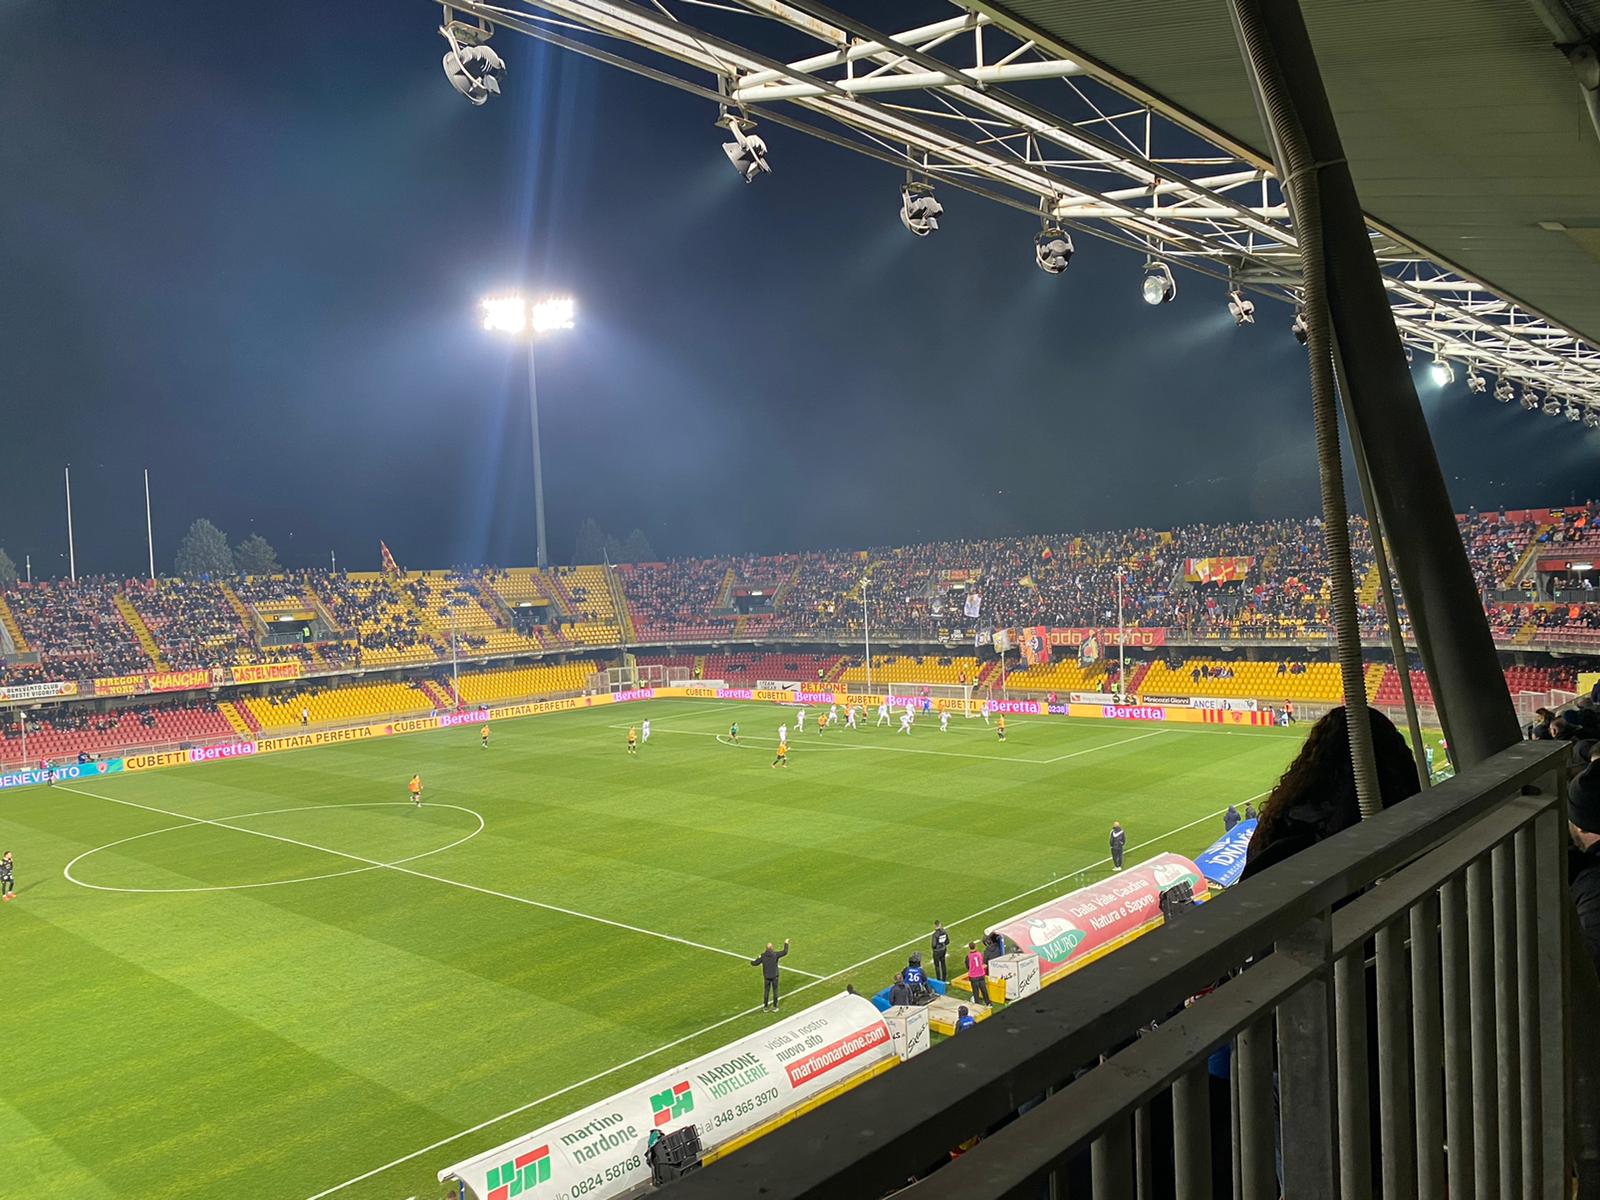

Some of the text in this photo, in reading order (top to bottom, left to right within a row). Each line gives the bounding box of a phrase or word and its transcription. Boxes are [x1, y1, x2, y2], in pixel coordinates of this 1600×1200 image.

[95, 675, 144, 687] STREGONI
[149, 671, 208, 688] SHANGHAI
[615, 689, 651, 700] Beretta
[685, 688, 713, 696] CUBETTI
[718, 689, 751, 699] Beretta
[758, 691, 787, 700] CUBETTI
[796, 692, 832, 703] Beretta
[846, 695, 881, 705] CUBETTI
[989, 700, 1039, 713] Beretta
[1104, 705, 1160, 719] Beretta
[127, 751, 187, 769] CUBETTI
[195, 742, 250, 760] Beretta
[257, 734, 313, 751] FRITTATA
[316, 727, 371, 743] PERFETTA
[394, 718, 438, 732] CUBETTI
[443, 710, 487, 726] Beretta
[490, 704, 532, 719] FRITTATA
[534, 700, 576, 712] PERFETTA
[1070, 900, 1097, 918] Dalla
[1095, 889, 1117, 908] Valle
[1113, 877, 1149, 898] Caudina
[1089, 893, 1155, 931] Natura e Sapore
[973, 956, 979, 967] 1
[1042, 932, 1078, 962] MAURO
[908, 972, 920, 982] 26
[765, 1017, 829, 1051] visita il nostro
[776, 1033, 824, 1063] nuovo sito
[698, 1051, 760, 1087] NARDONE
[790, 1026, 886, 1081] martinonardone.com
[709, 1063, 769, 1100] HOTELLERIE
[714, 1109, 735, 1128] 348
[735, 1099, 754, 1117] 365
[755, 1087, 779, 1108] 3970
[560, 1112, 624, 1146] martino
[572, 1124, 638, 1164] nardone
[571, 1173, 604, 1198] 0824
[605, 1155, 641, 1181] 58768
